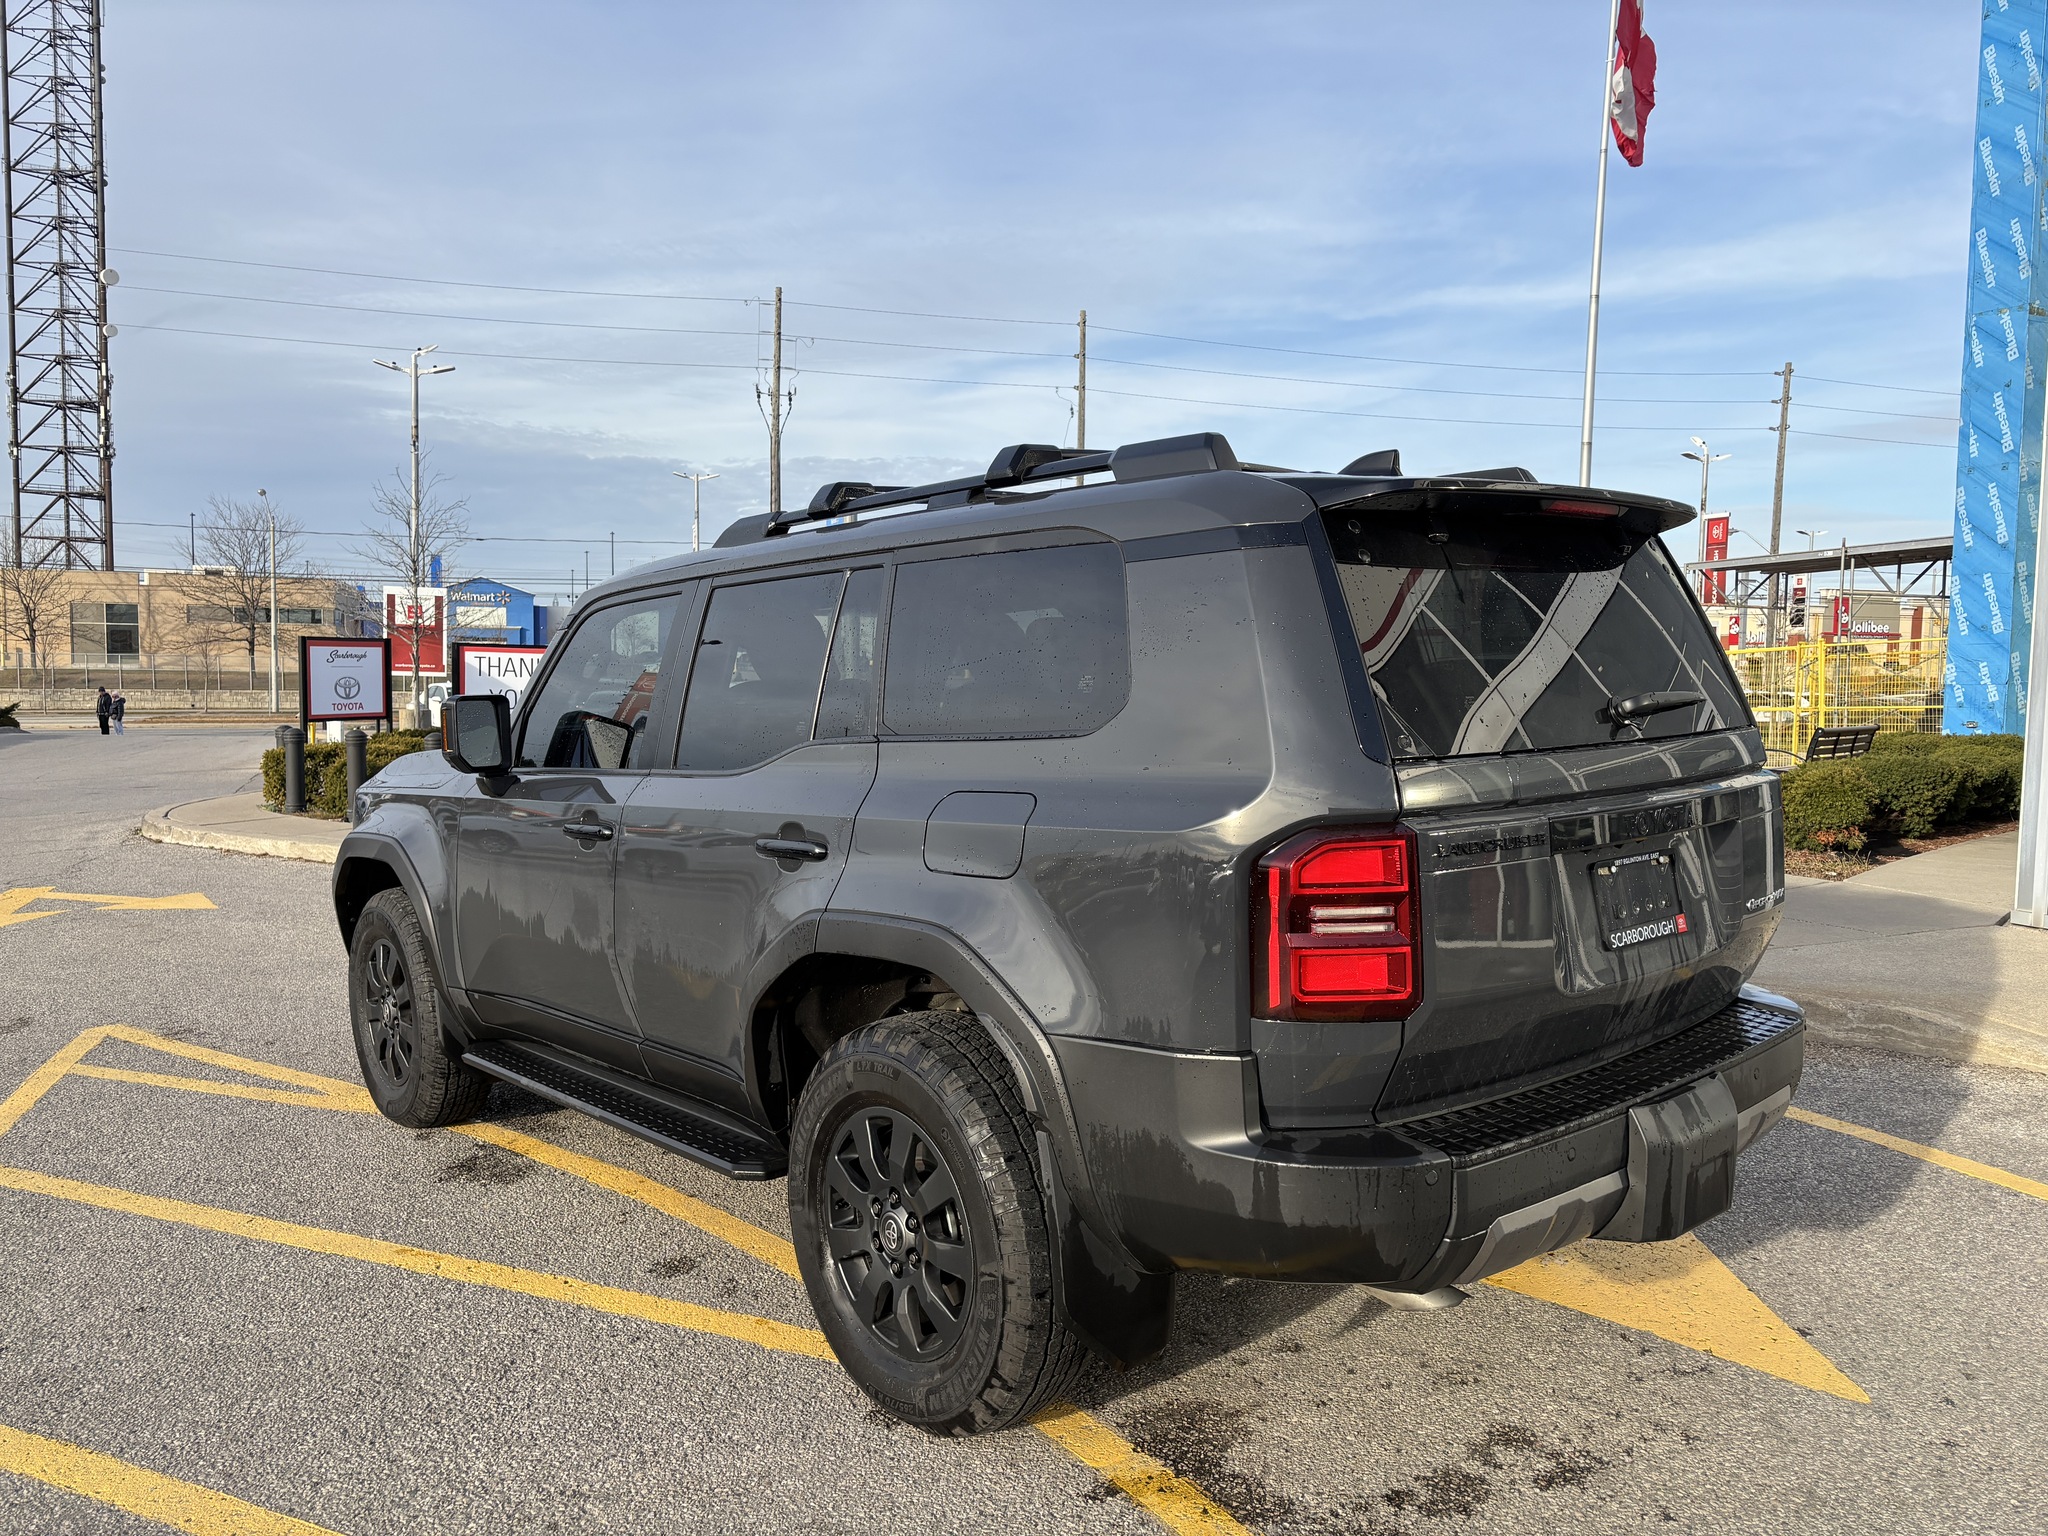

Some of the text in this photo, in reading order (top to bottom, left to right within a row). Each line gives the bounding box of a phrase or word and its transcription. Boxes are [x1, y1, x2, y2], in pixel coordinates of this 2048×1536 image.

[1983, 43, 2005, 105] Blueskin
[1979, 136, 2001, 198] Blueskin
[2014, 123, 2035, 187] Blueskin
[1975, 227, 1996, 289] Blueskin
[2009, 217, 2032, 280] Blueskin
[1993, 391, 2014, 453] Blueskin
[1956, 486, 1974, 548] Blueskin
[1988, 481, 2009, 544] Blueskin
[451, 592, 495, 602] Walmart
[1951, 575, 1969, 636] Blueskin
[1982, 572, 2004, 635] Blueskin
[2017, 561, 2032, 624] Blueskin
[1850, 620, 1890, 633] Jollibee
[474, 656, 540, 678] THAN
[332, 702, 364, 711] TOYOTA
[1624, 806, 1696, 840] TOYOTA
[1611, 919, 1674, 948] SCARBOROUGH
[873, 1062, 894, 1078] TRAIL
